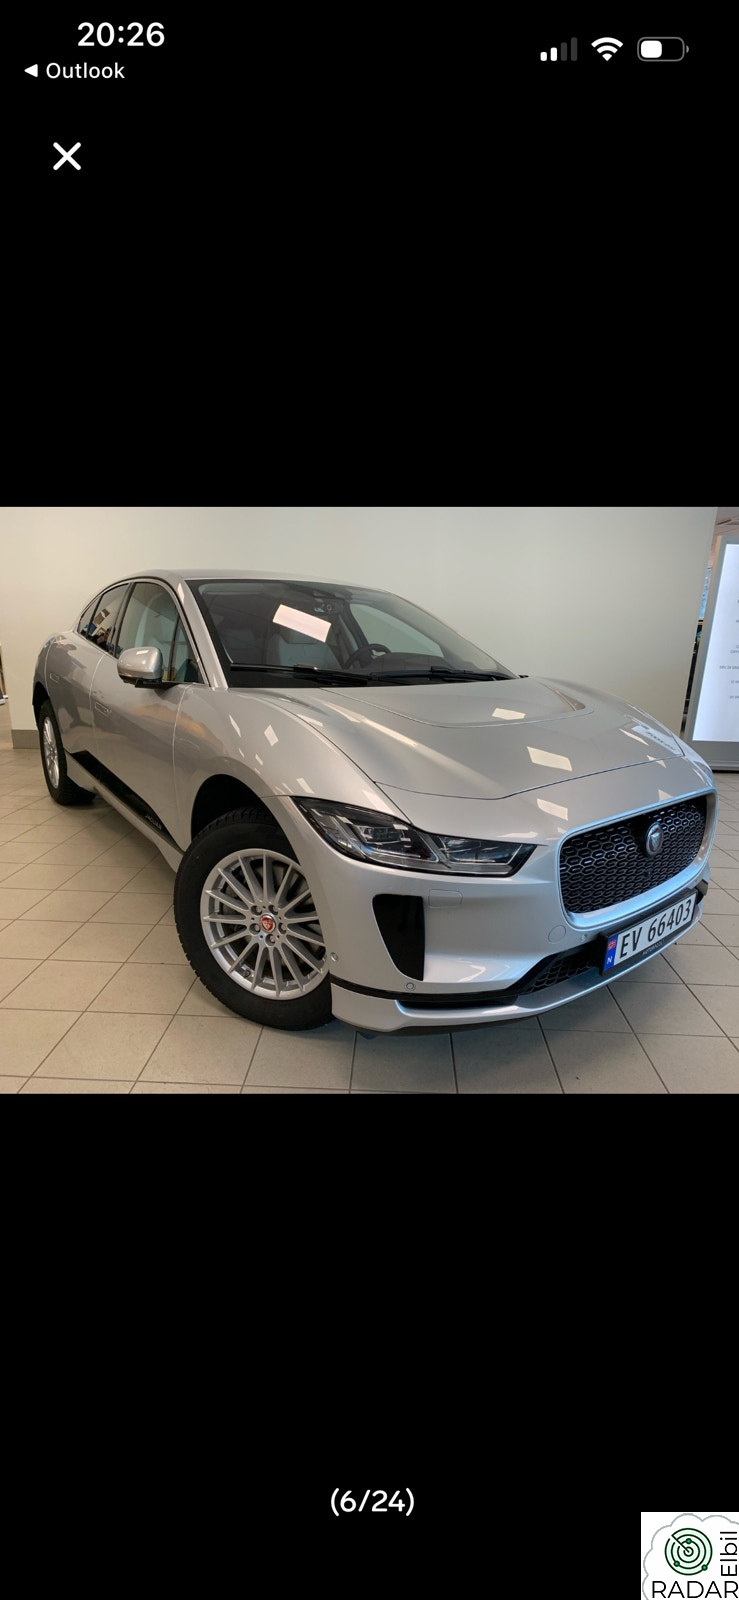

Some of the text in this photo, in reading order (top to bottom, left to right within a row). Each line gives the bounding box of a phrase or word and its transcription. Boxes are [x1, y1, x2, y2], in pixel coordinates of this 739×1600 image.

[619, 926, 643, 959] EV
[647, 898, 692, 943] 66403
[606, 956, 613, 965] N
